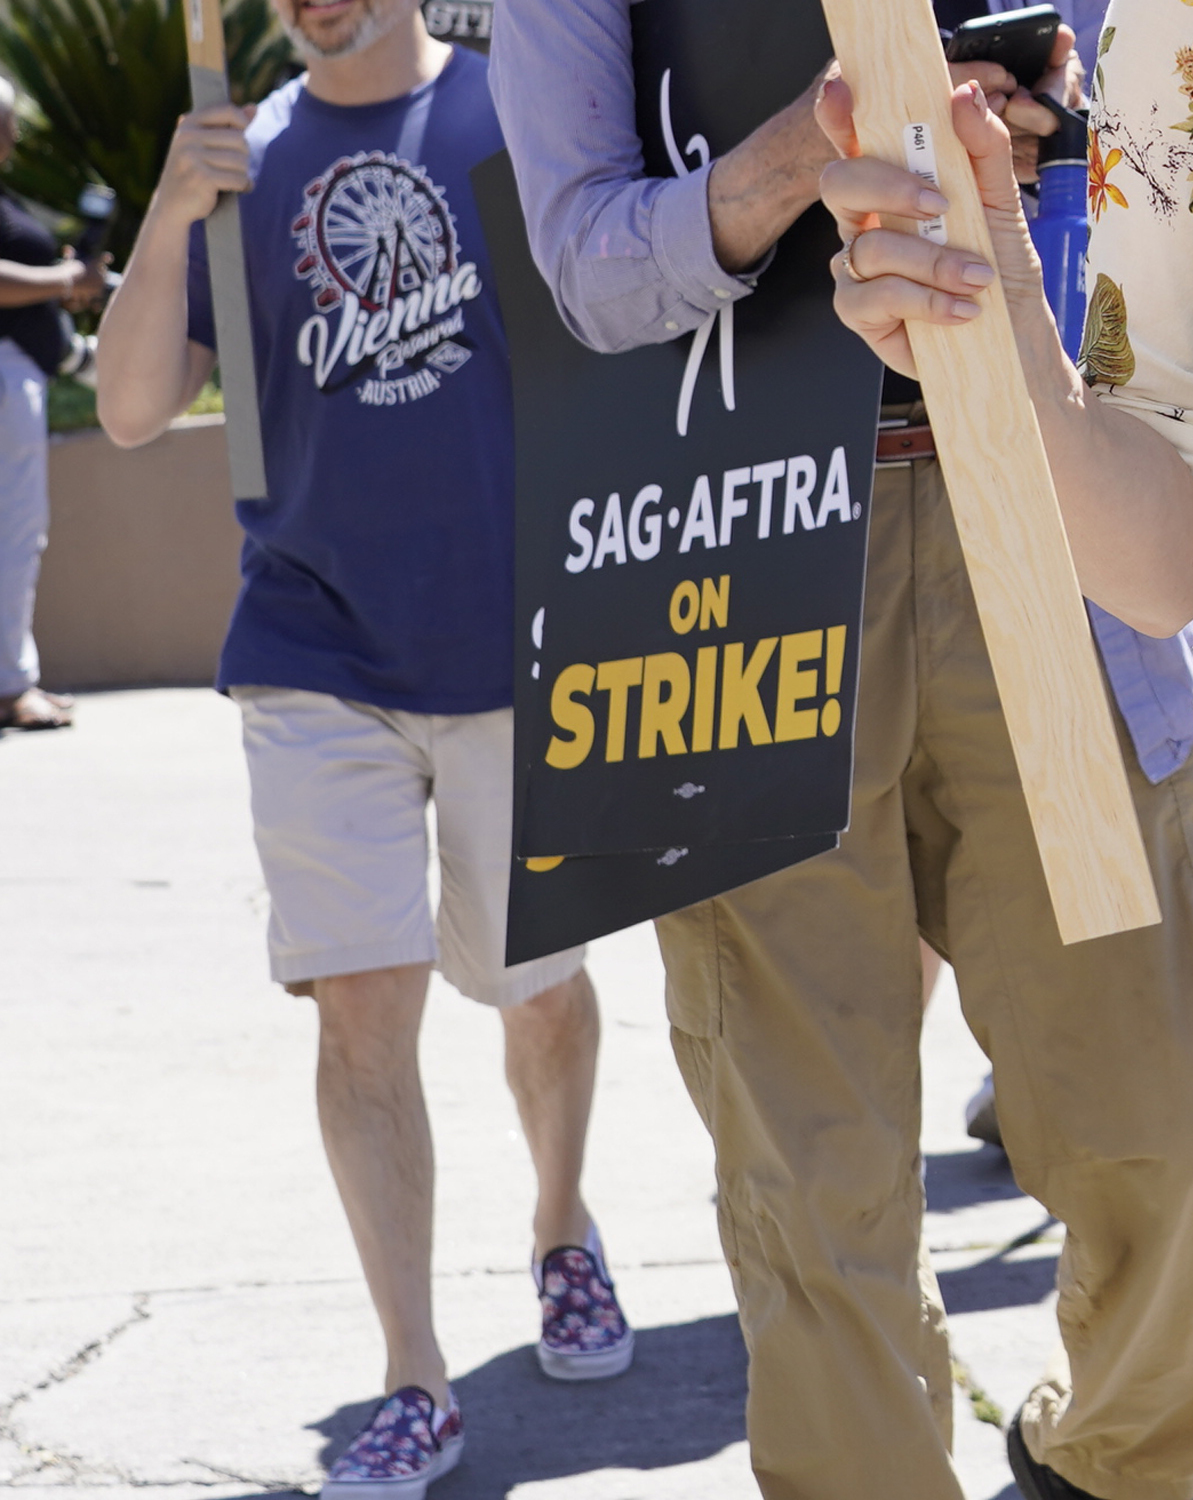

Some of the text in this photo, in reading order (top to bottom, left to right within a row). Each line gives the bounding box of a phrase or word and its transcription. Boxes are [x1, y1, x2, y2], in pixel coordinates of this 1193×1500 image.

[912, 125, 926, 151] P461
[297, 261, 482, 390] Vienna
[359, 367, 441, 406] AUSTRIA
[669, 575, 731, 635] ON
[544, 624, 848, 769] STRIKE!
